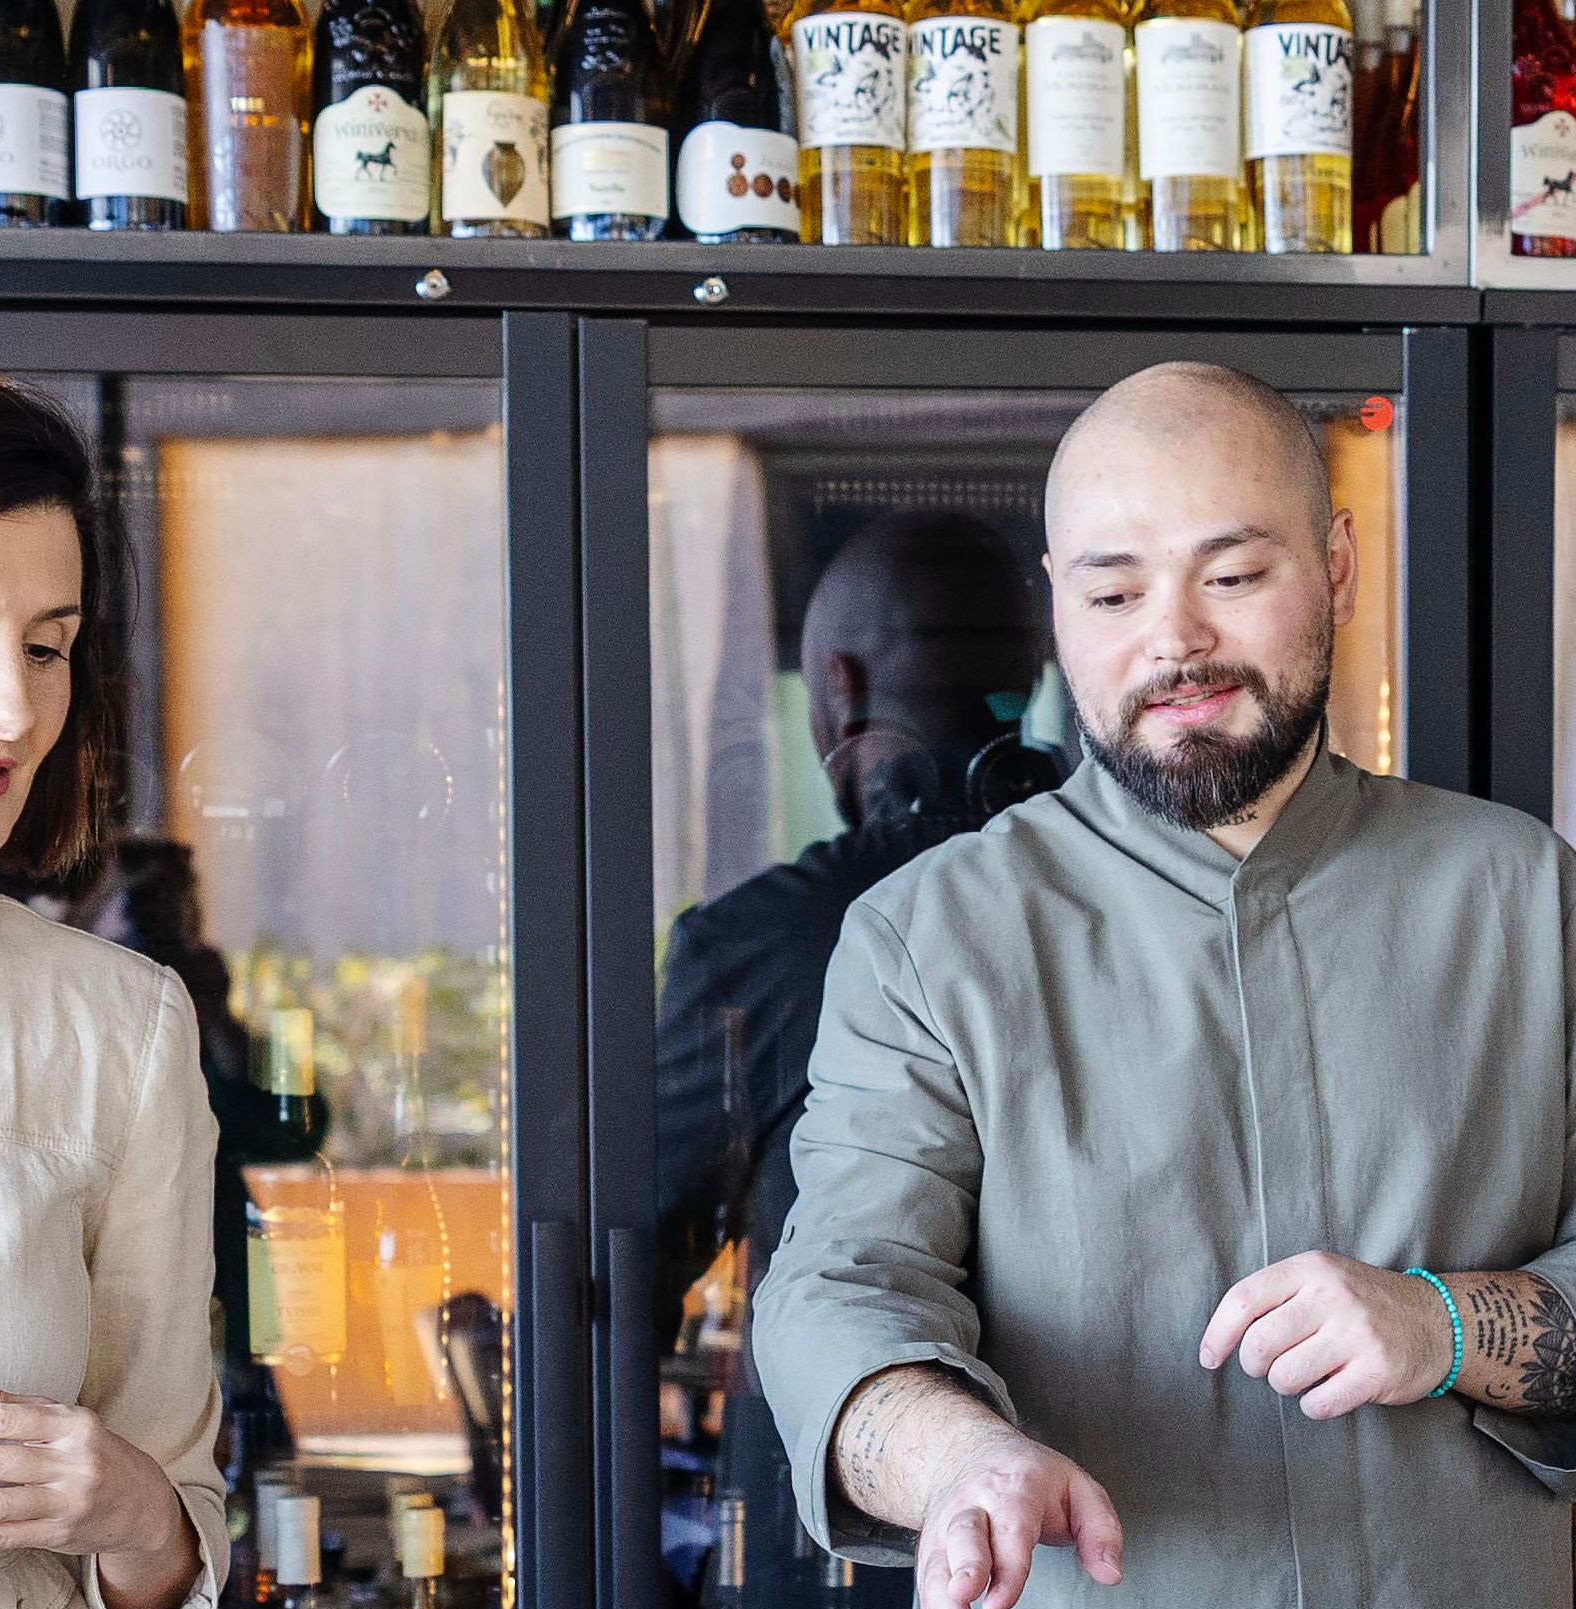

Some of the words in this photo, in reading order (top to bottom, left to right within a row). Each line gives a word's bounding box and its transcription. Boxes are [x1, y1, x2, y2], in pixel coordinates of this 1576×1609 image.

[803, 21, 901, 57] VINTAGE
[908, 26, 1002, 60] INTAGE
[1278, 32, 1351, 66] VINTA
[92, 155, 153, 174] ORGO
